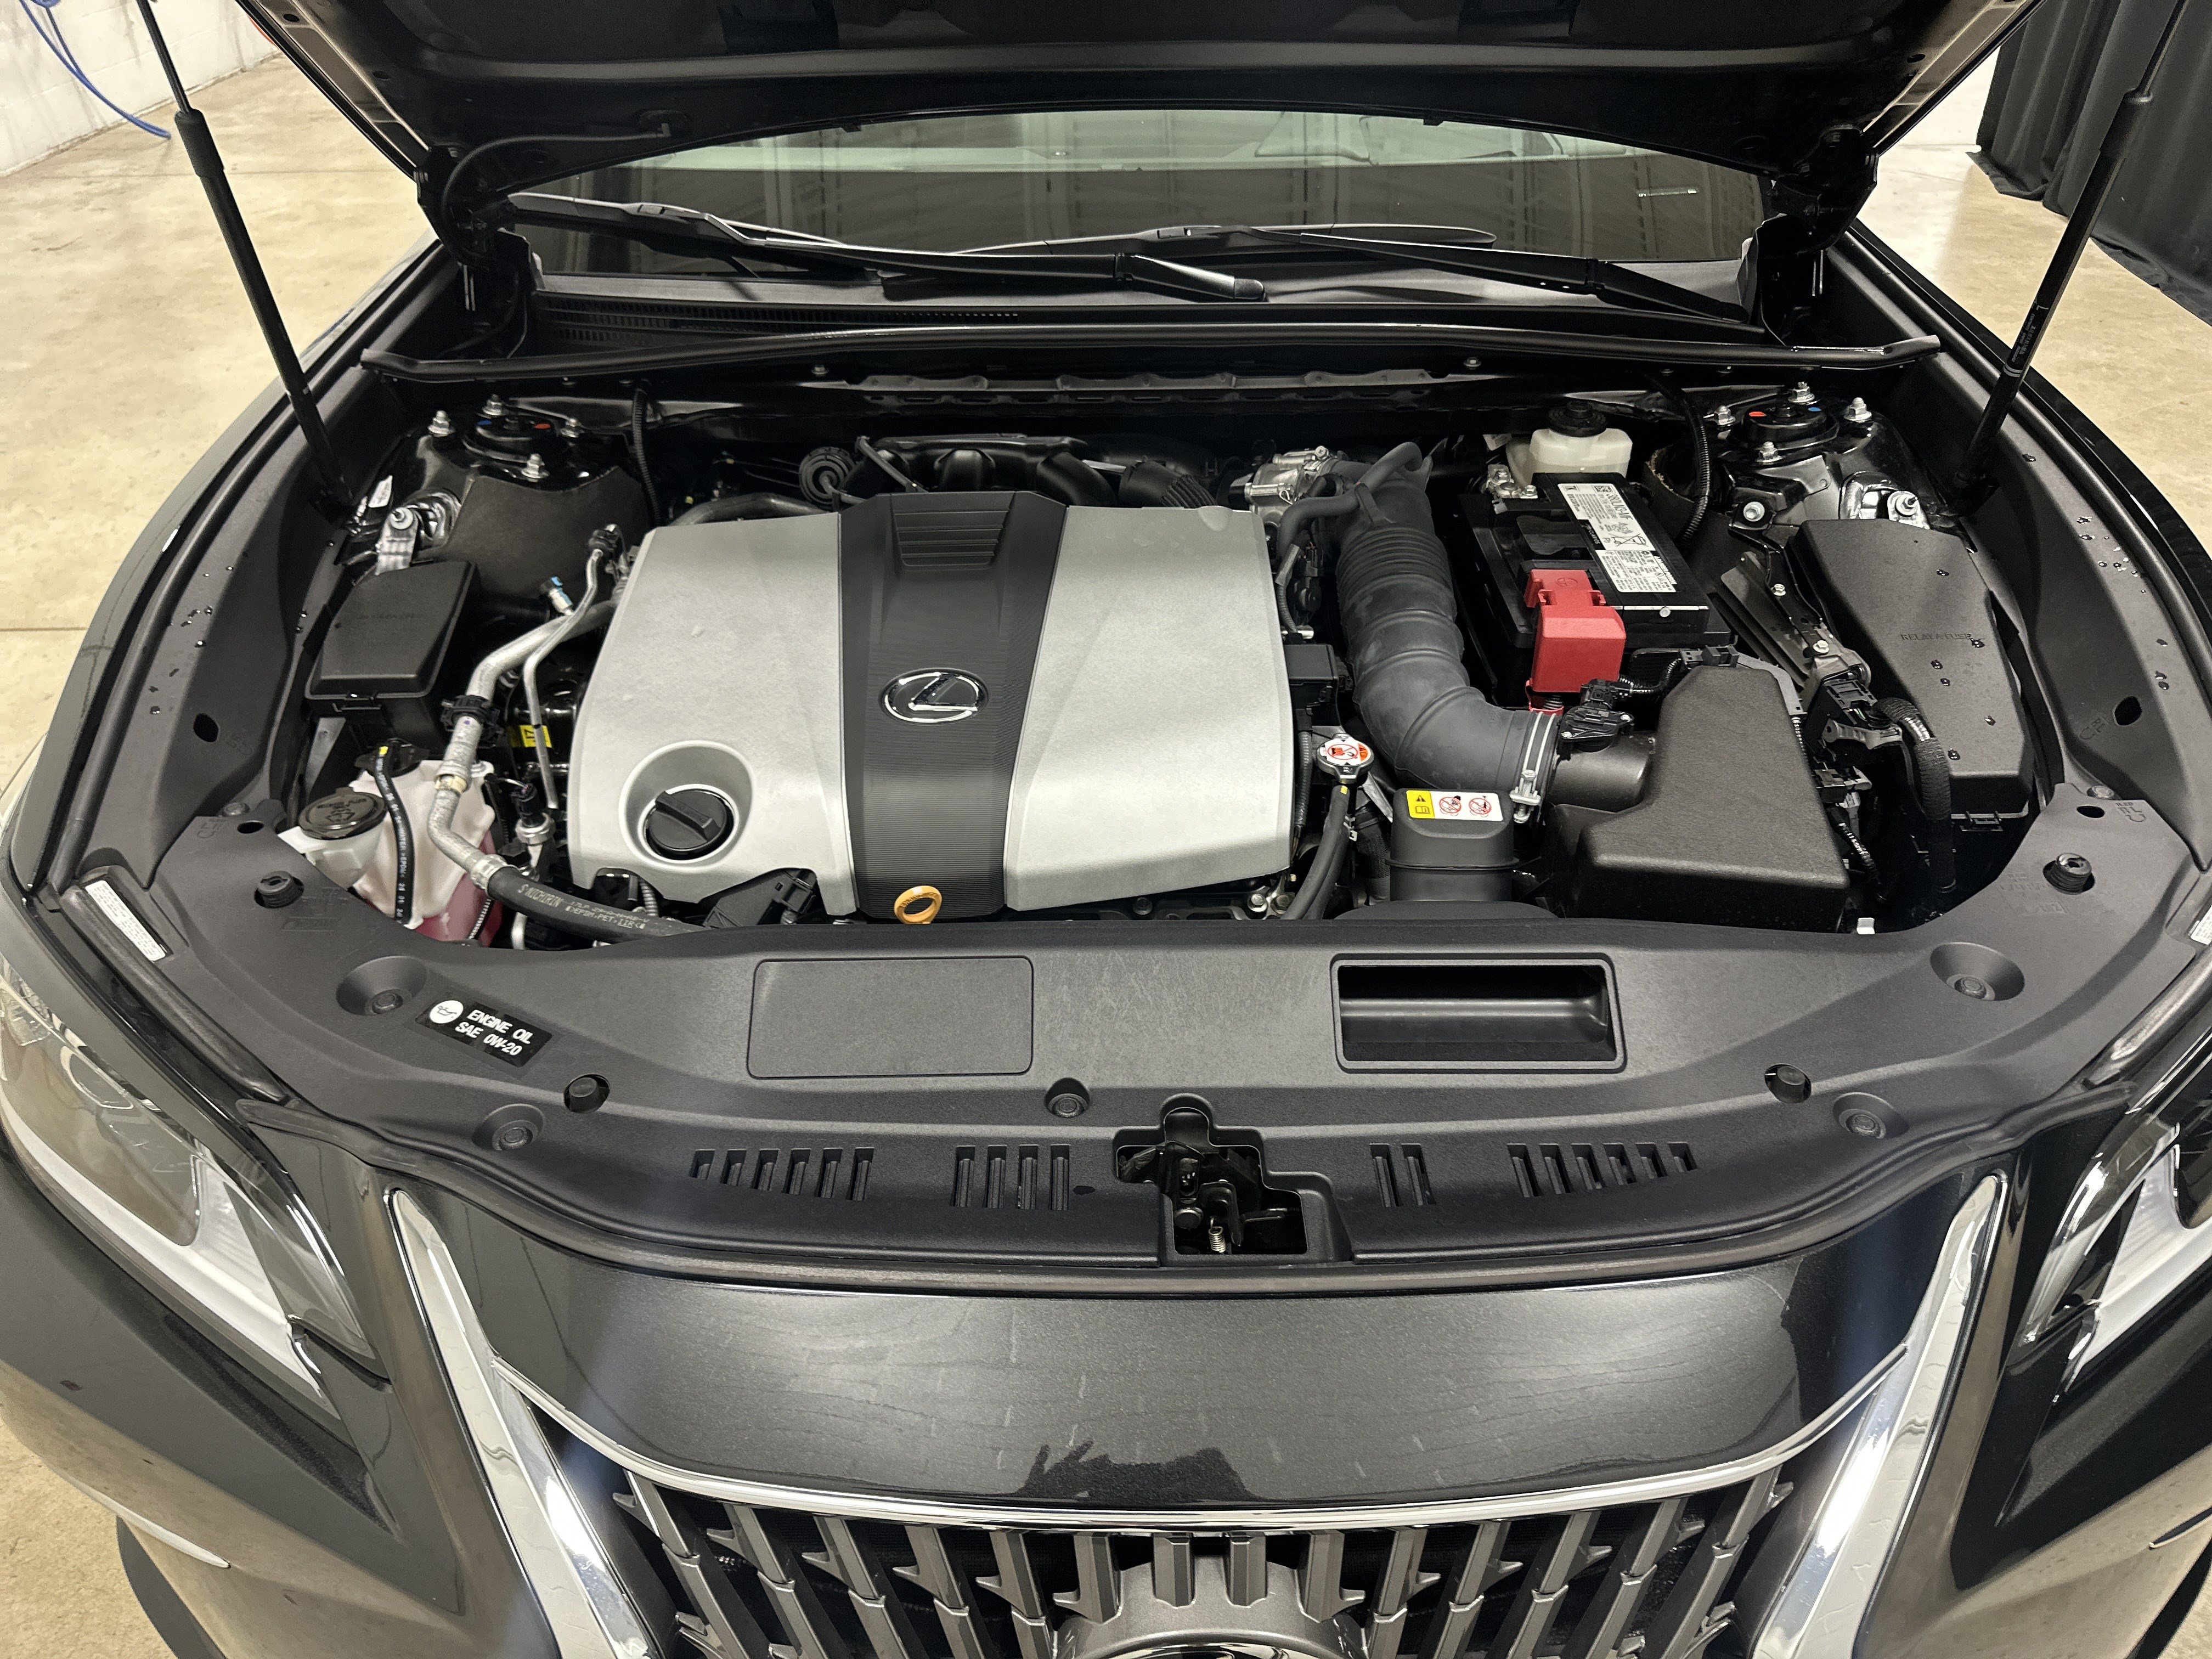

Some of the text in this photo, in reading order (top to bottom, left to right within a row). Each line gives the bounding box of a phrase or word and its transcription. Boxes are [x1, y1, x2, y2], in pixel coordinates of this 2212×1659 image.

[455, 1021, 522, 1056] SAE 0W-20
[467, 1009, 534, 1045] ENGINE OIL
